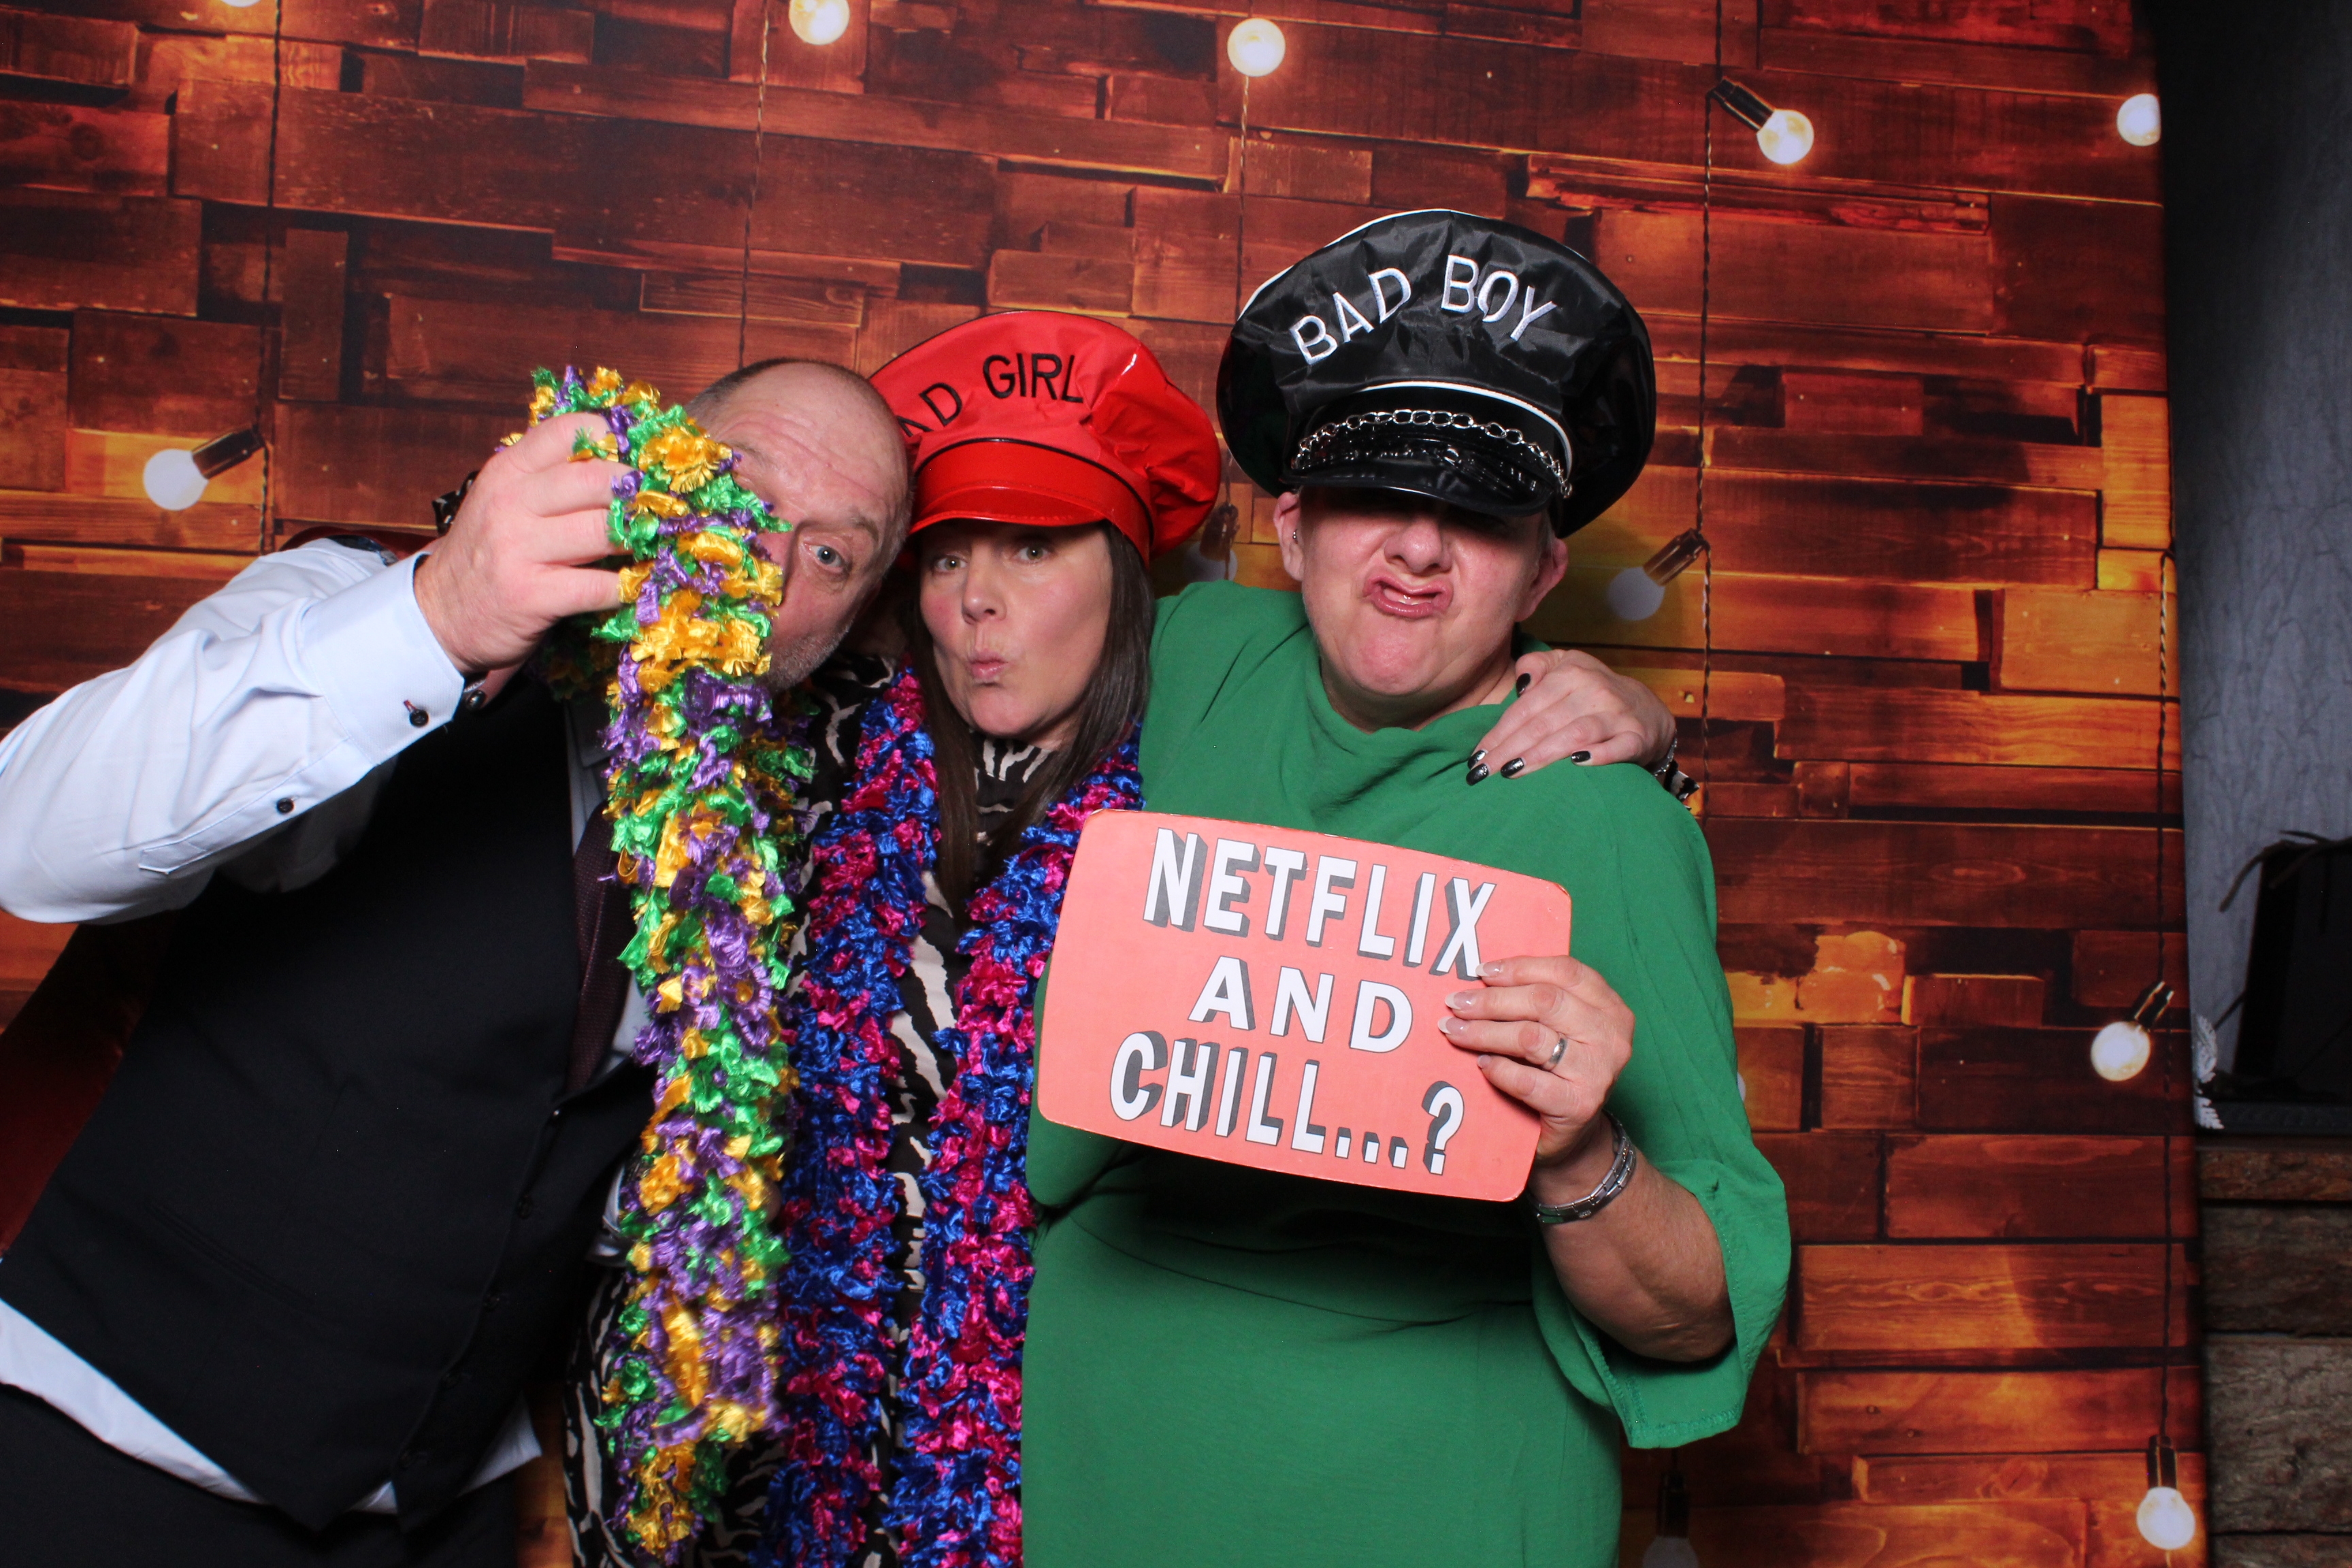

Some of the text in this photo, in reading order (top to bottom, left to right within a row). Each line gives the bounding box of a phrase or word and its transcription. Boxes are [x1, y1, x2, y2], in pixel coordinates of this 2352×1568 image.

[1290, 255, 1558, 365] BAD BOY
[983, 353, 1083, 404] GIRL
[1143, 828, 1497, 980] NETFLIX
[1188, 956, 1414, 1053] AND
